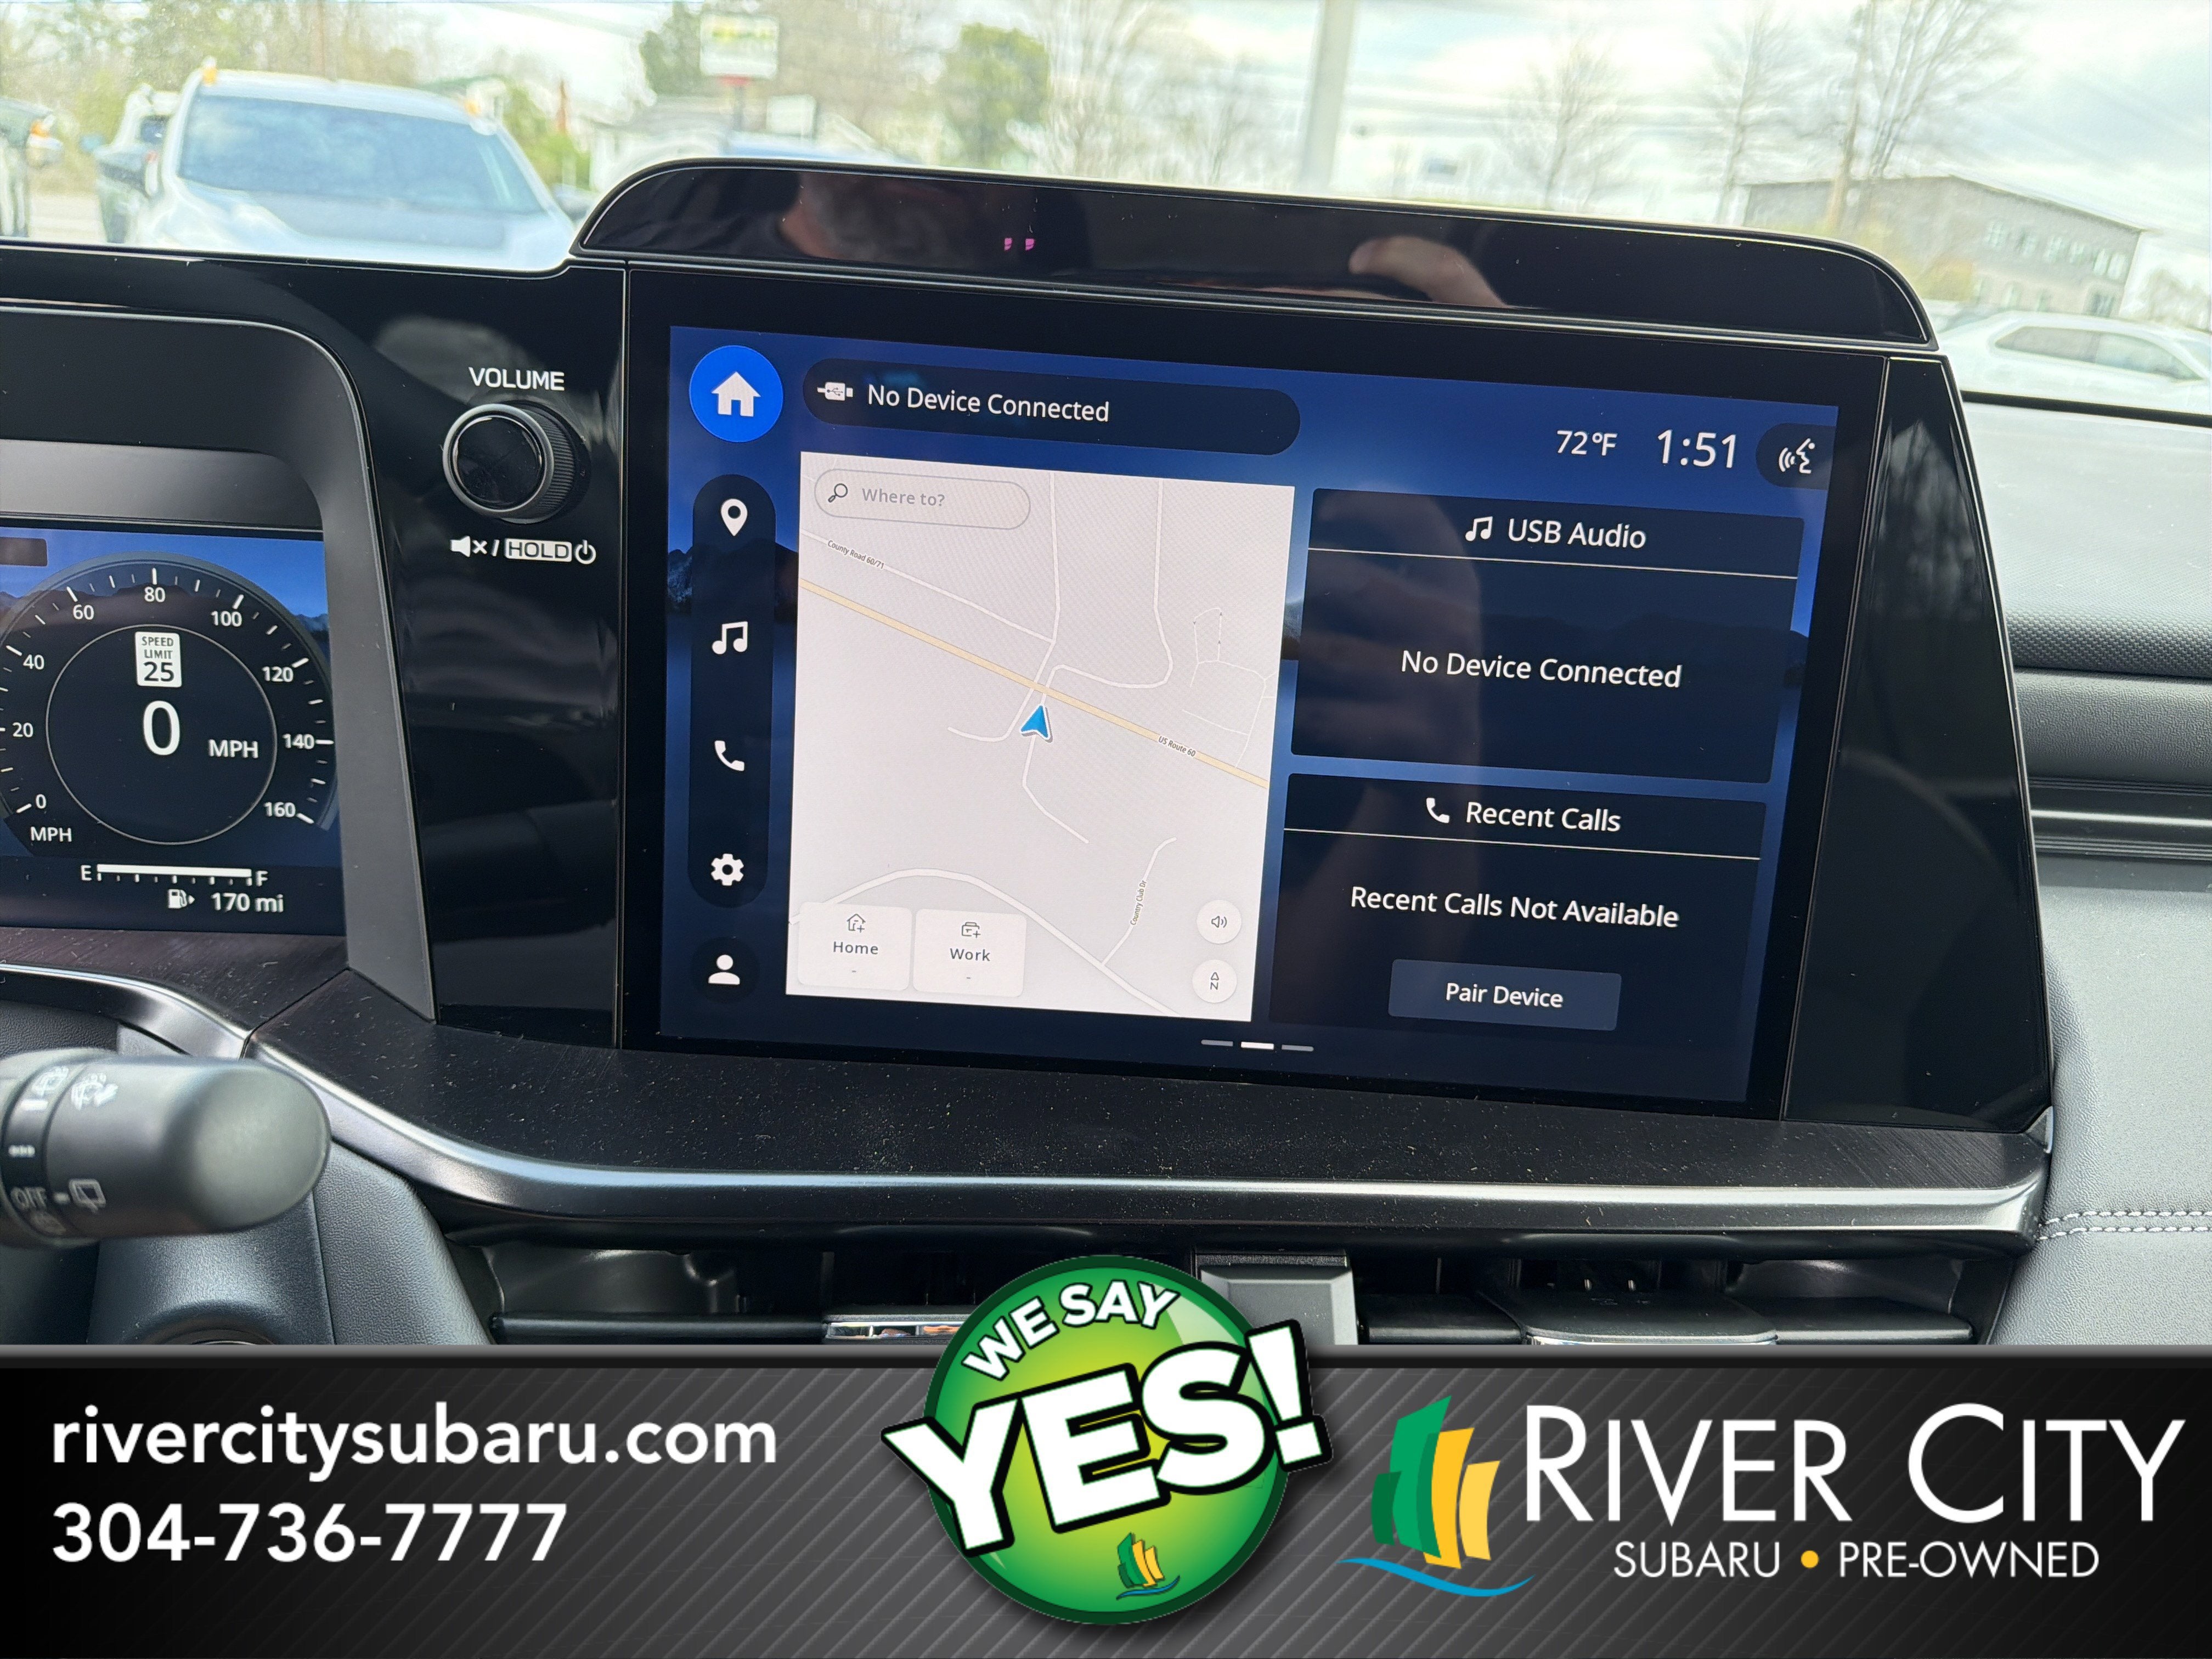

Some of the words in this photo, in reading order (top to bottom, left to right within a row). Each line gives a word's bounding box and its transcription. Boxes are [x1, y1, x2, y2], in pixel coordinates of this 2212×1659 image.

[469, 367, 565, 391] VOLUME
[868, 384, 900, 407] No
[907, 388, 981, 413] Device
[988, 394, 1110, 422] Connected
[1657, 429, 1737, 469] 1:51
[862, 488, 916, 506] Where
[921, 492, 945, 507] to?
[1508, 518, 1562, 544] USB
[1567, 522, 1646, 549] Audio
[509, 541, 569, 558] HOLD
[827, 540, 849, 555] County
[850, 549, 866, 561] Road
[867, 557, 884, 569] 60/71
[144, 587, 165, 602] 80
[73, 605, 94, 620] 60
[211, 611, 242, 627] 100
[142, 636, 174, 647] SPEED
[144, 648, 173, 659] LIMIT
[23, 655, 44, 670] 40
[1401, 650, 1438, 674] No
[1447, 653, 1531, 679] Device
[1539, 658, 1681, 689] Connected
[143, 662, 174, 682] 25
[263, 667, 294, 682] 120
[13, 723, 33, 738] 20
[143, 701, 180, 755] 0
[208, 740, 258, 758] MPH
[284, 734, 315, 749] 140
[1159, 736, 1168, 745] US
[1168, 740, 1187, 753] Route
[35, 794, 47, 809] 0
[264, 802, 296, 818] 160
[1466, 802, 1554, 829] Recent
[1561, 806, 1621, 832] Calls
[31, 827, 72, 842] MPH
[81, 866, 92, 881] E
[257, 871, 268, 887] F
[212, 894, 250, 911] 170
[256, 895, 284, 912] mi
[1136, 889, 1144, 901] Club
[1130, 902, 1143, 925] Country
[1351, 886, 1437, 912] Recent
[1444, 891, 1502, 917] Calls
[1510, 896, 1556, 921] Not
[1562, 900, 1679, 928] Available
[833, 941, 878, 955] Home
[950, 948, 991, 962] Work
[1446, 983, 1487, 1003] Pair
[1493, 985, 1564, 1008] Device
